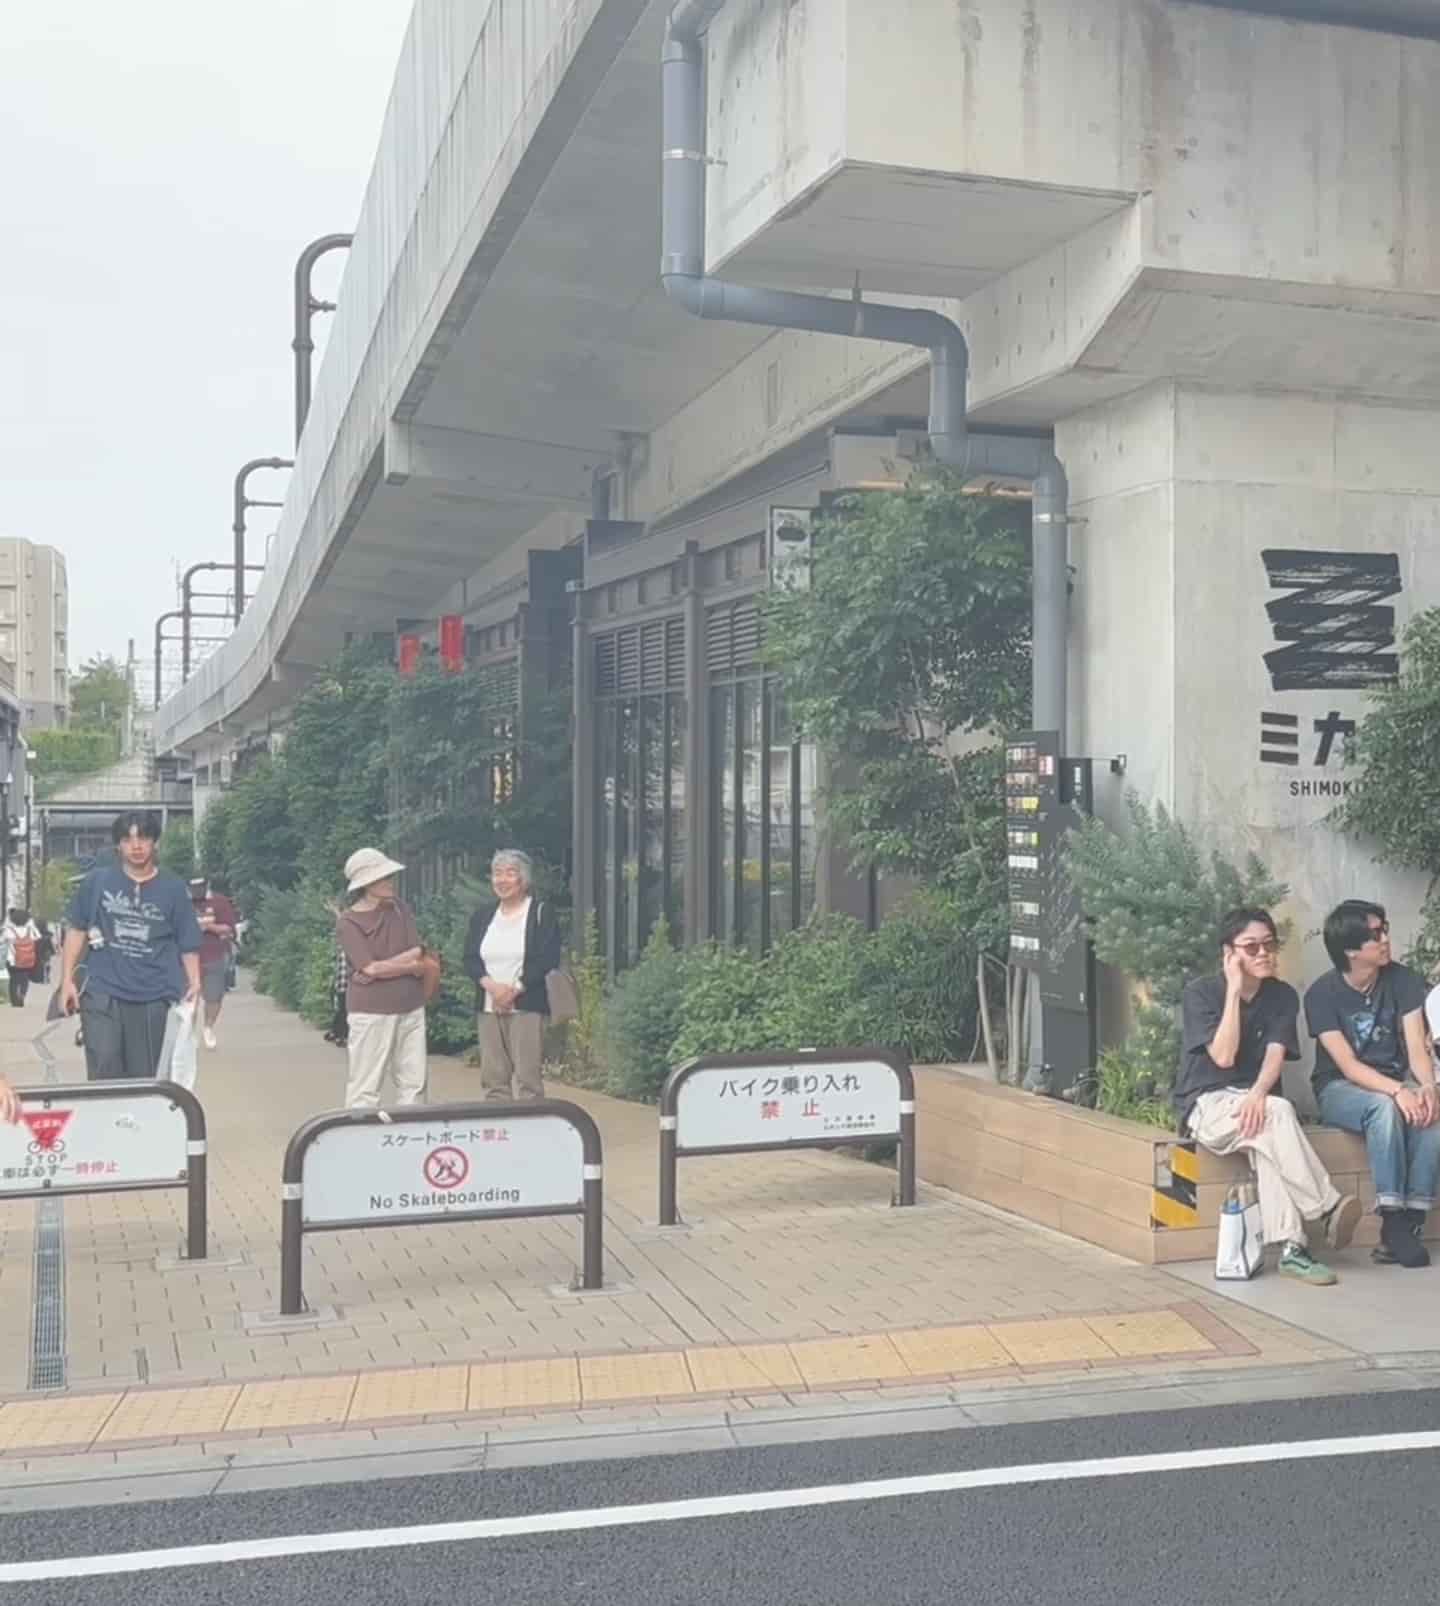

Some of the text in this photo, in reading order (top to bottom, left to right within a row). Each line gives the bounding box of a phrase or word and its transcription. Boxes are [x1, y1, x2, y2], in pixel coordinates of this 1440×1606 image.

[719, 1074, 861, 1098] バイク乗り入れ
[25, 1153, 67, 1166] STOP
[370, 1188, 521, 1210] No Skateboarding
